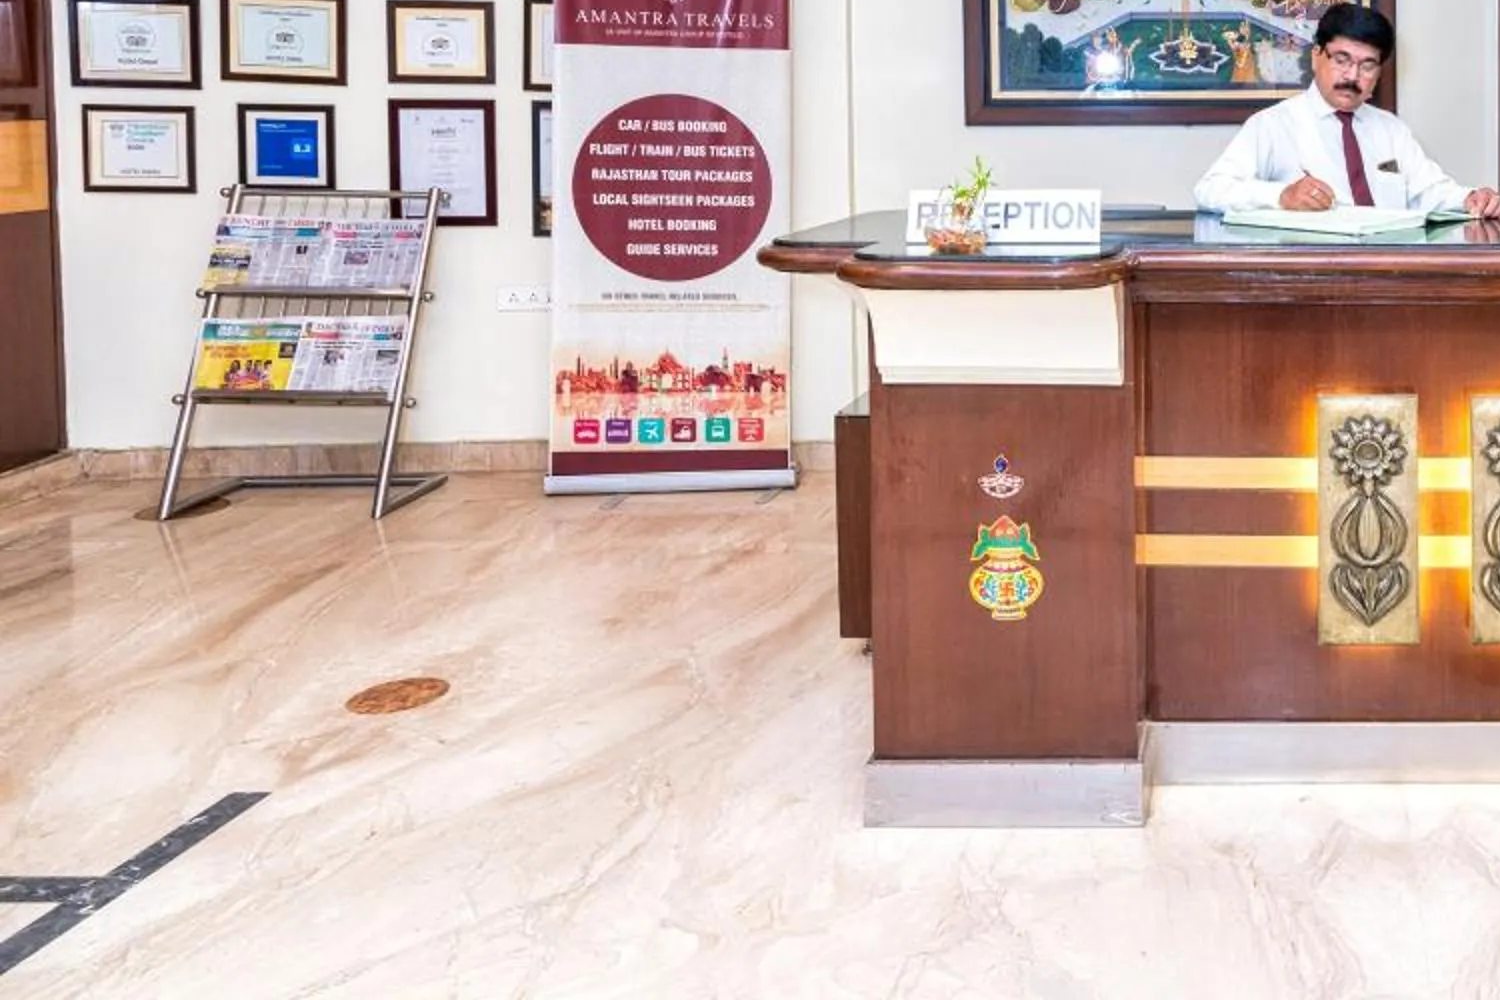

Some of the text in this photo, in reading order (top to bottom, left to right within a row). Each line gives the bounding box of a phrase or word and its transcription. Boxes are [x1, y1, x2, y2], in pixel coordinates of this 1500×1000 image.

[575, 9, 775, 29] AMANTRA TRAVELS
[618, 120, 727, 133] CAR / BUS BOOKING
[590, 144, 755, 157] FLIGHT / TRAIN / BUS TICKETS
[592, 169, 752, 182] RAJASTHAN TOUR PACKAGES
[593, 193, 755, 207] LOCAL SIGHTSEEN PACKAGES
[628, 219, 716, 231] HOTEL BOOKING
[627, 244, 718, 256] GUIDE SERVICES
